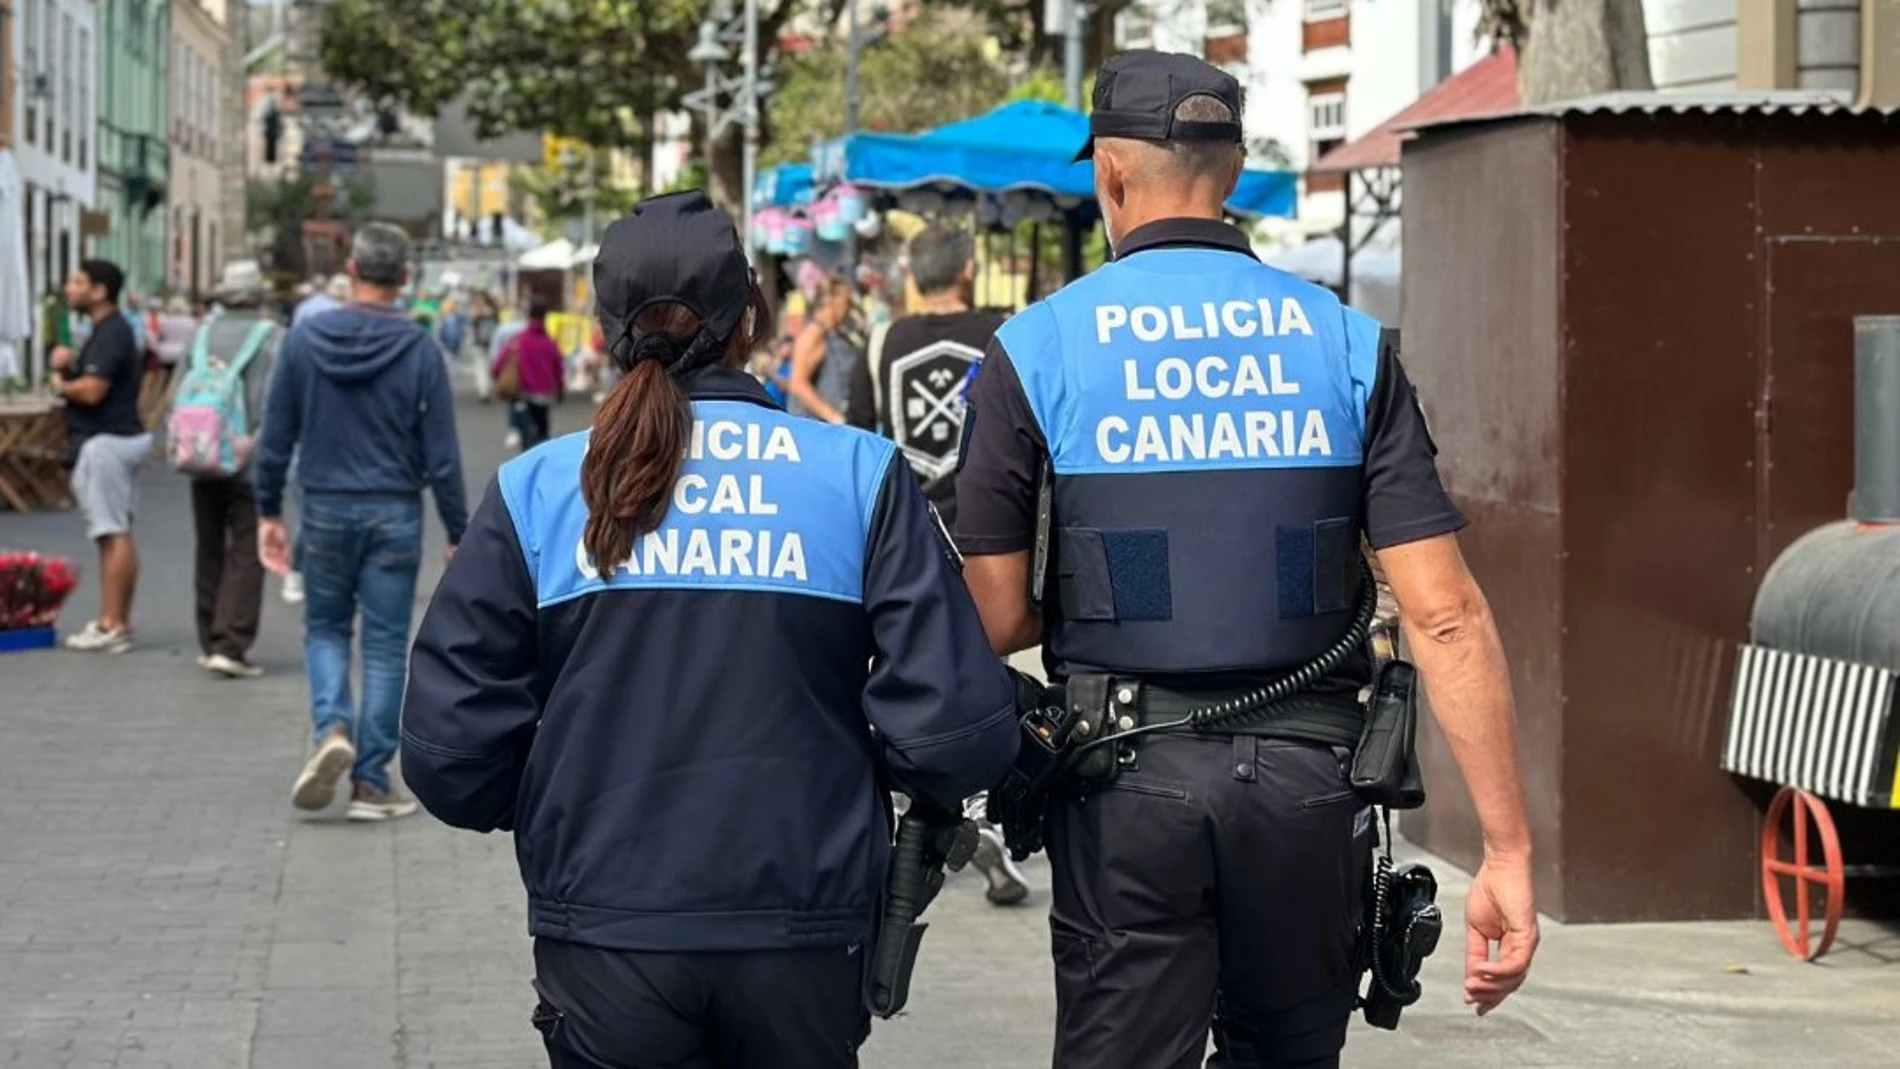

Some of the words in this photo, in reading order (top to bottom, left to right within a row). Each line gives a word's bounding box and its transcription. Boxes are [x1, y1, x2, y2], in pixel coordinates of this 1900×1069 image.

[1095, 298, 1313, 344] POLICIA
[1124, 354, 1299, 400] LOCAL
[584, 420, 801, 463] ICIA
[1096, 409, 1331, 463] CANARIA
[674, 474, 778, 514] CAL
